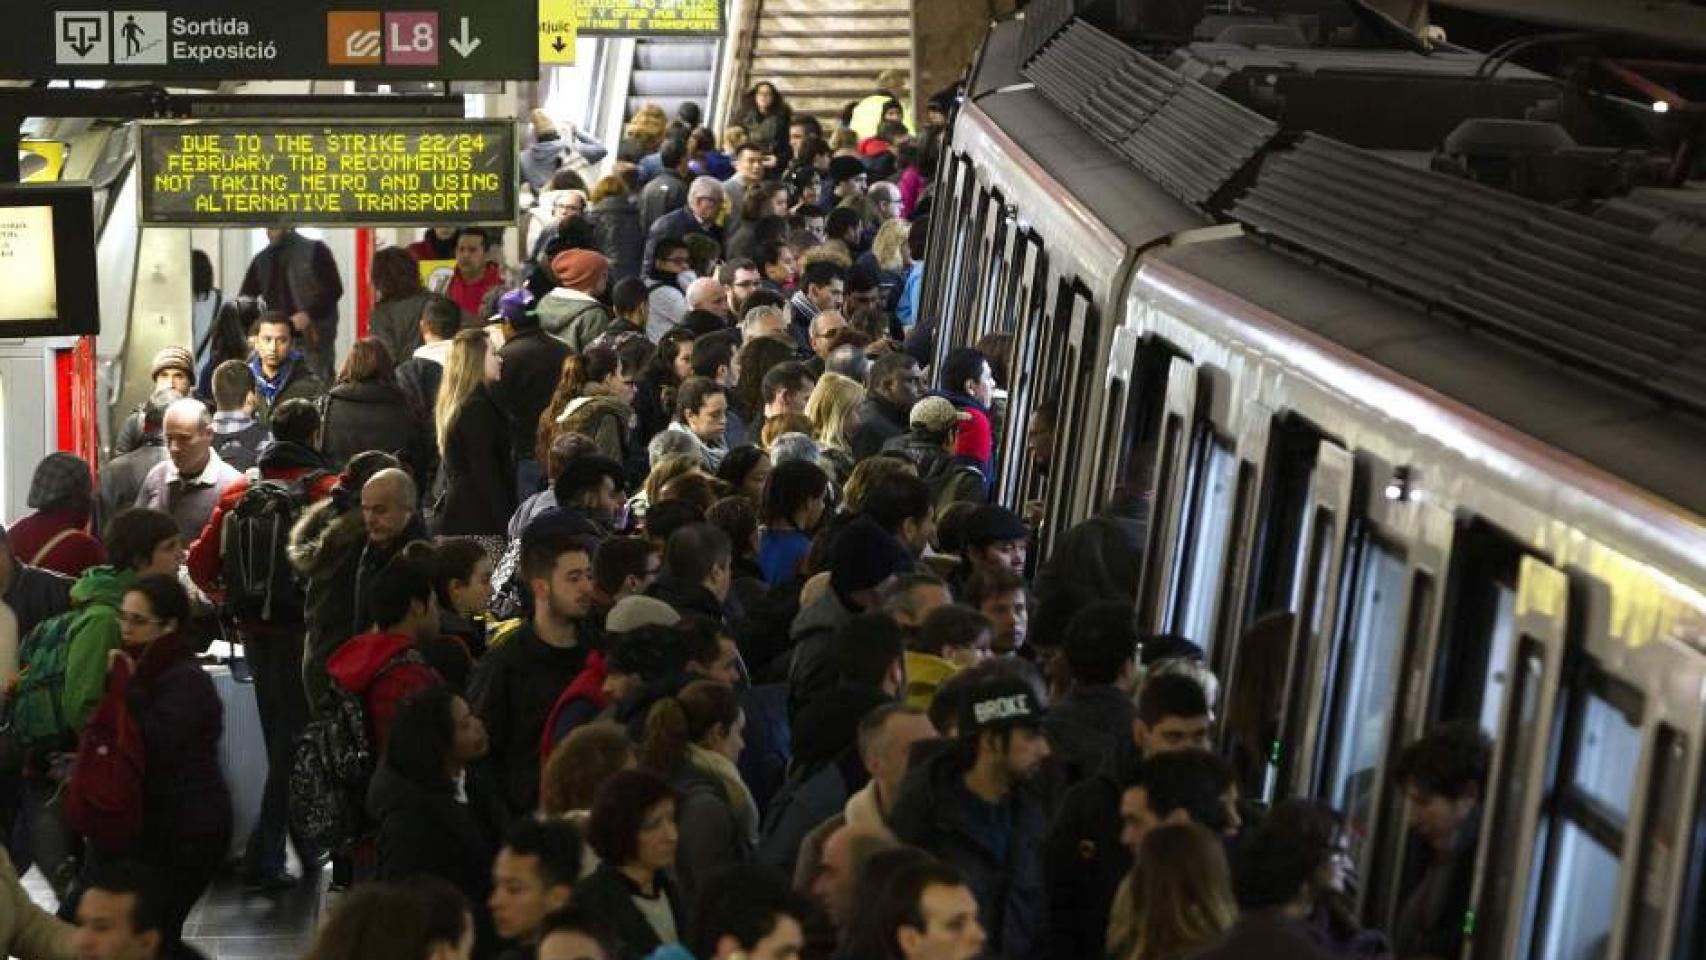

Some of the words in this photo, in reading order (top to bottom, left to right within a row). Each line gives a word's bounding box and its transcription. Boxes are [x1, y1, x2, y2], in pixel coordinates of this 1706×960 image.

[172, 17, 249, 35] Sortida
[390, 22, 434, 52] L8
[173, 41, 278, 63] Exposició
[181, 135, 221, 152] DUE
[234, 135, 261, 152] TO
[275, 135, 313, 152] THE
[327, 134, 406, 152] STRIKE
[419, 134, 485, 152] 22/24
[168, 154, 273, 171] FEBRUARY
[288, 154, 327, 171] TMB
[340, 154, 472, 171] RECOMMENDS
[155, 174, 194, 192] NOT
[210, 174, 288, 192] TAKING
[301, 174, 367, 191] METRO
[380, 174, 420, 191] AND
[433, 173, 499, 191] USING
[195, 194, 341, 212] ALTERNATIVE
[354, 193, 472, 211] TRANSPORT
[974, 693, 1031, 723] BROKE
